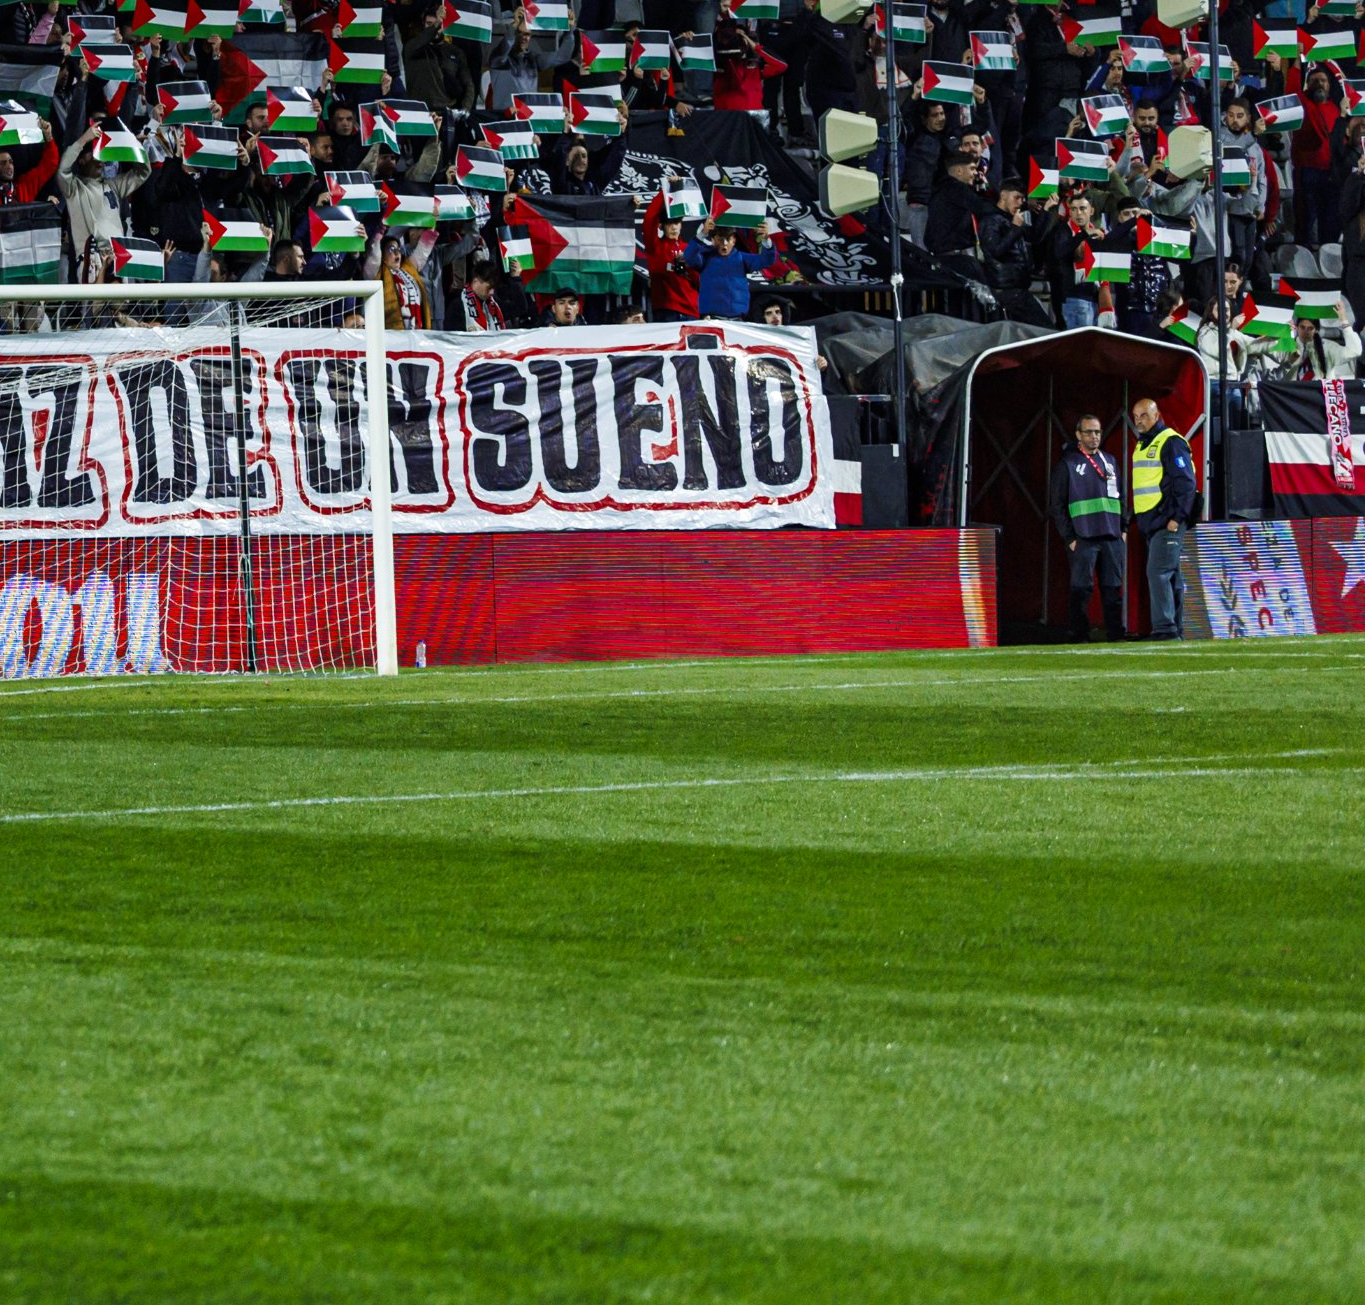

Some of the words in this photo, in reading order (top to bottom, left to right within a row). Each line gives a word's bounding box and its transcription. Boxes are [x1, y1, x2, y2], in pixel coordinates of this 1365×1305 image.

[119, 358, 267, 504] DE
[286, 358, 440, 495] UN
[467, 333, 804, 493] SUEÑO
